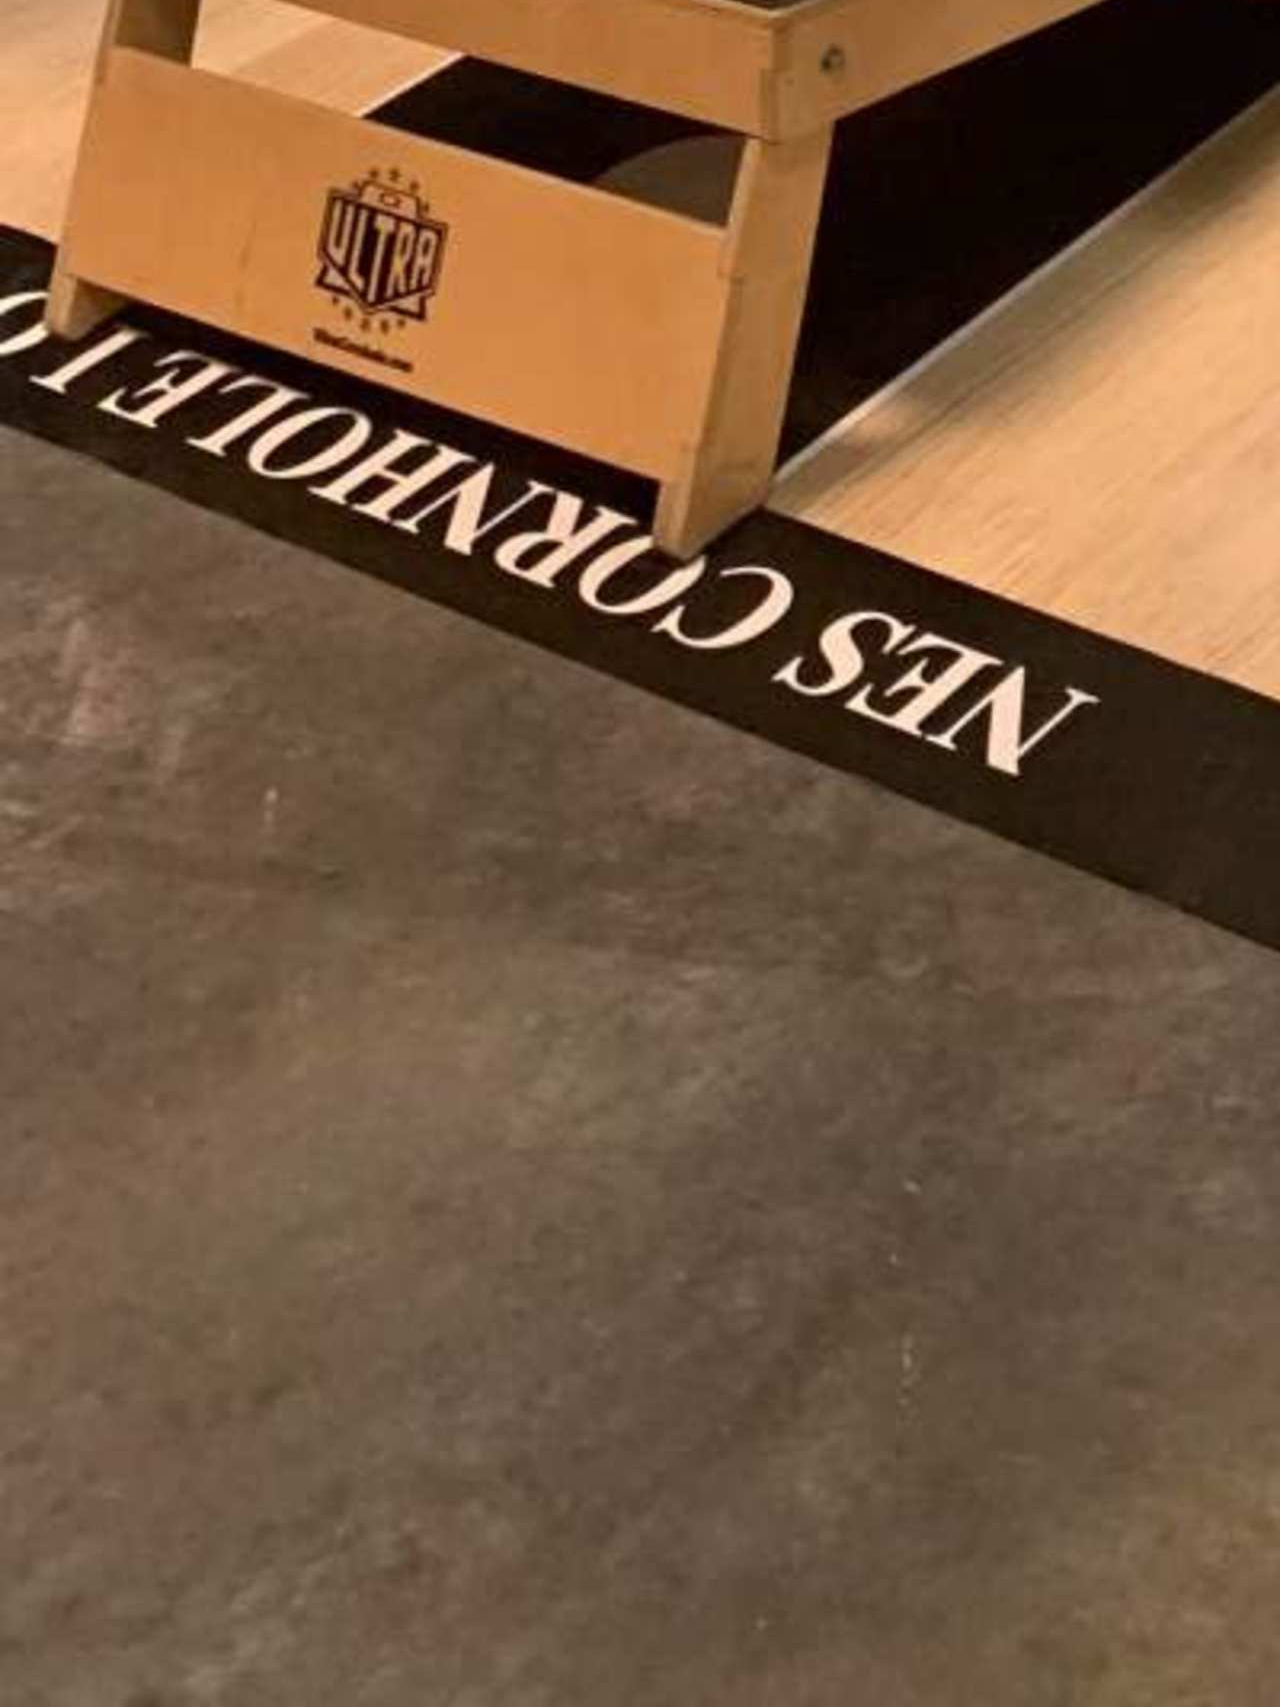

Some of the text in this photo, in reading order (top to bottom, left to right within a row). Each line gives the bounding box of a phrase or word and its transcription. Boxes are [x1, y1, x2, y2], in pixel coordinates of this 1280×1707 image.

[326, 195, 440, 305] ULTRA
[98, 350, 800, 659] CORNHOLE
[773, 607, 1098, 777] NES
